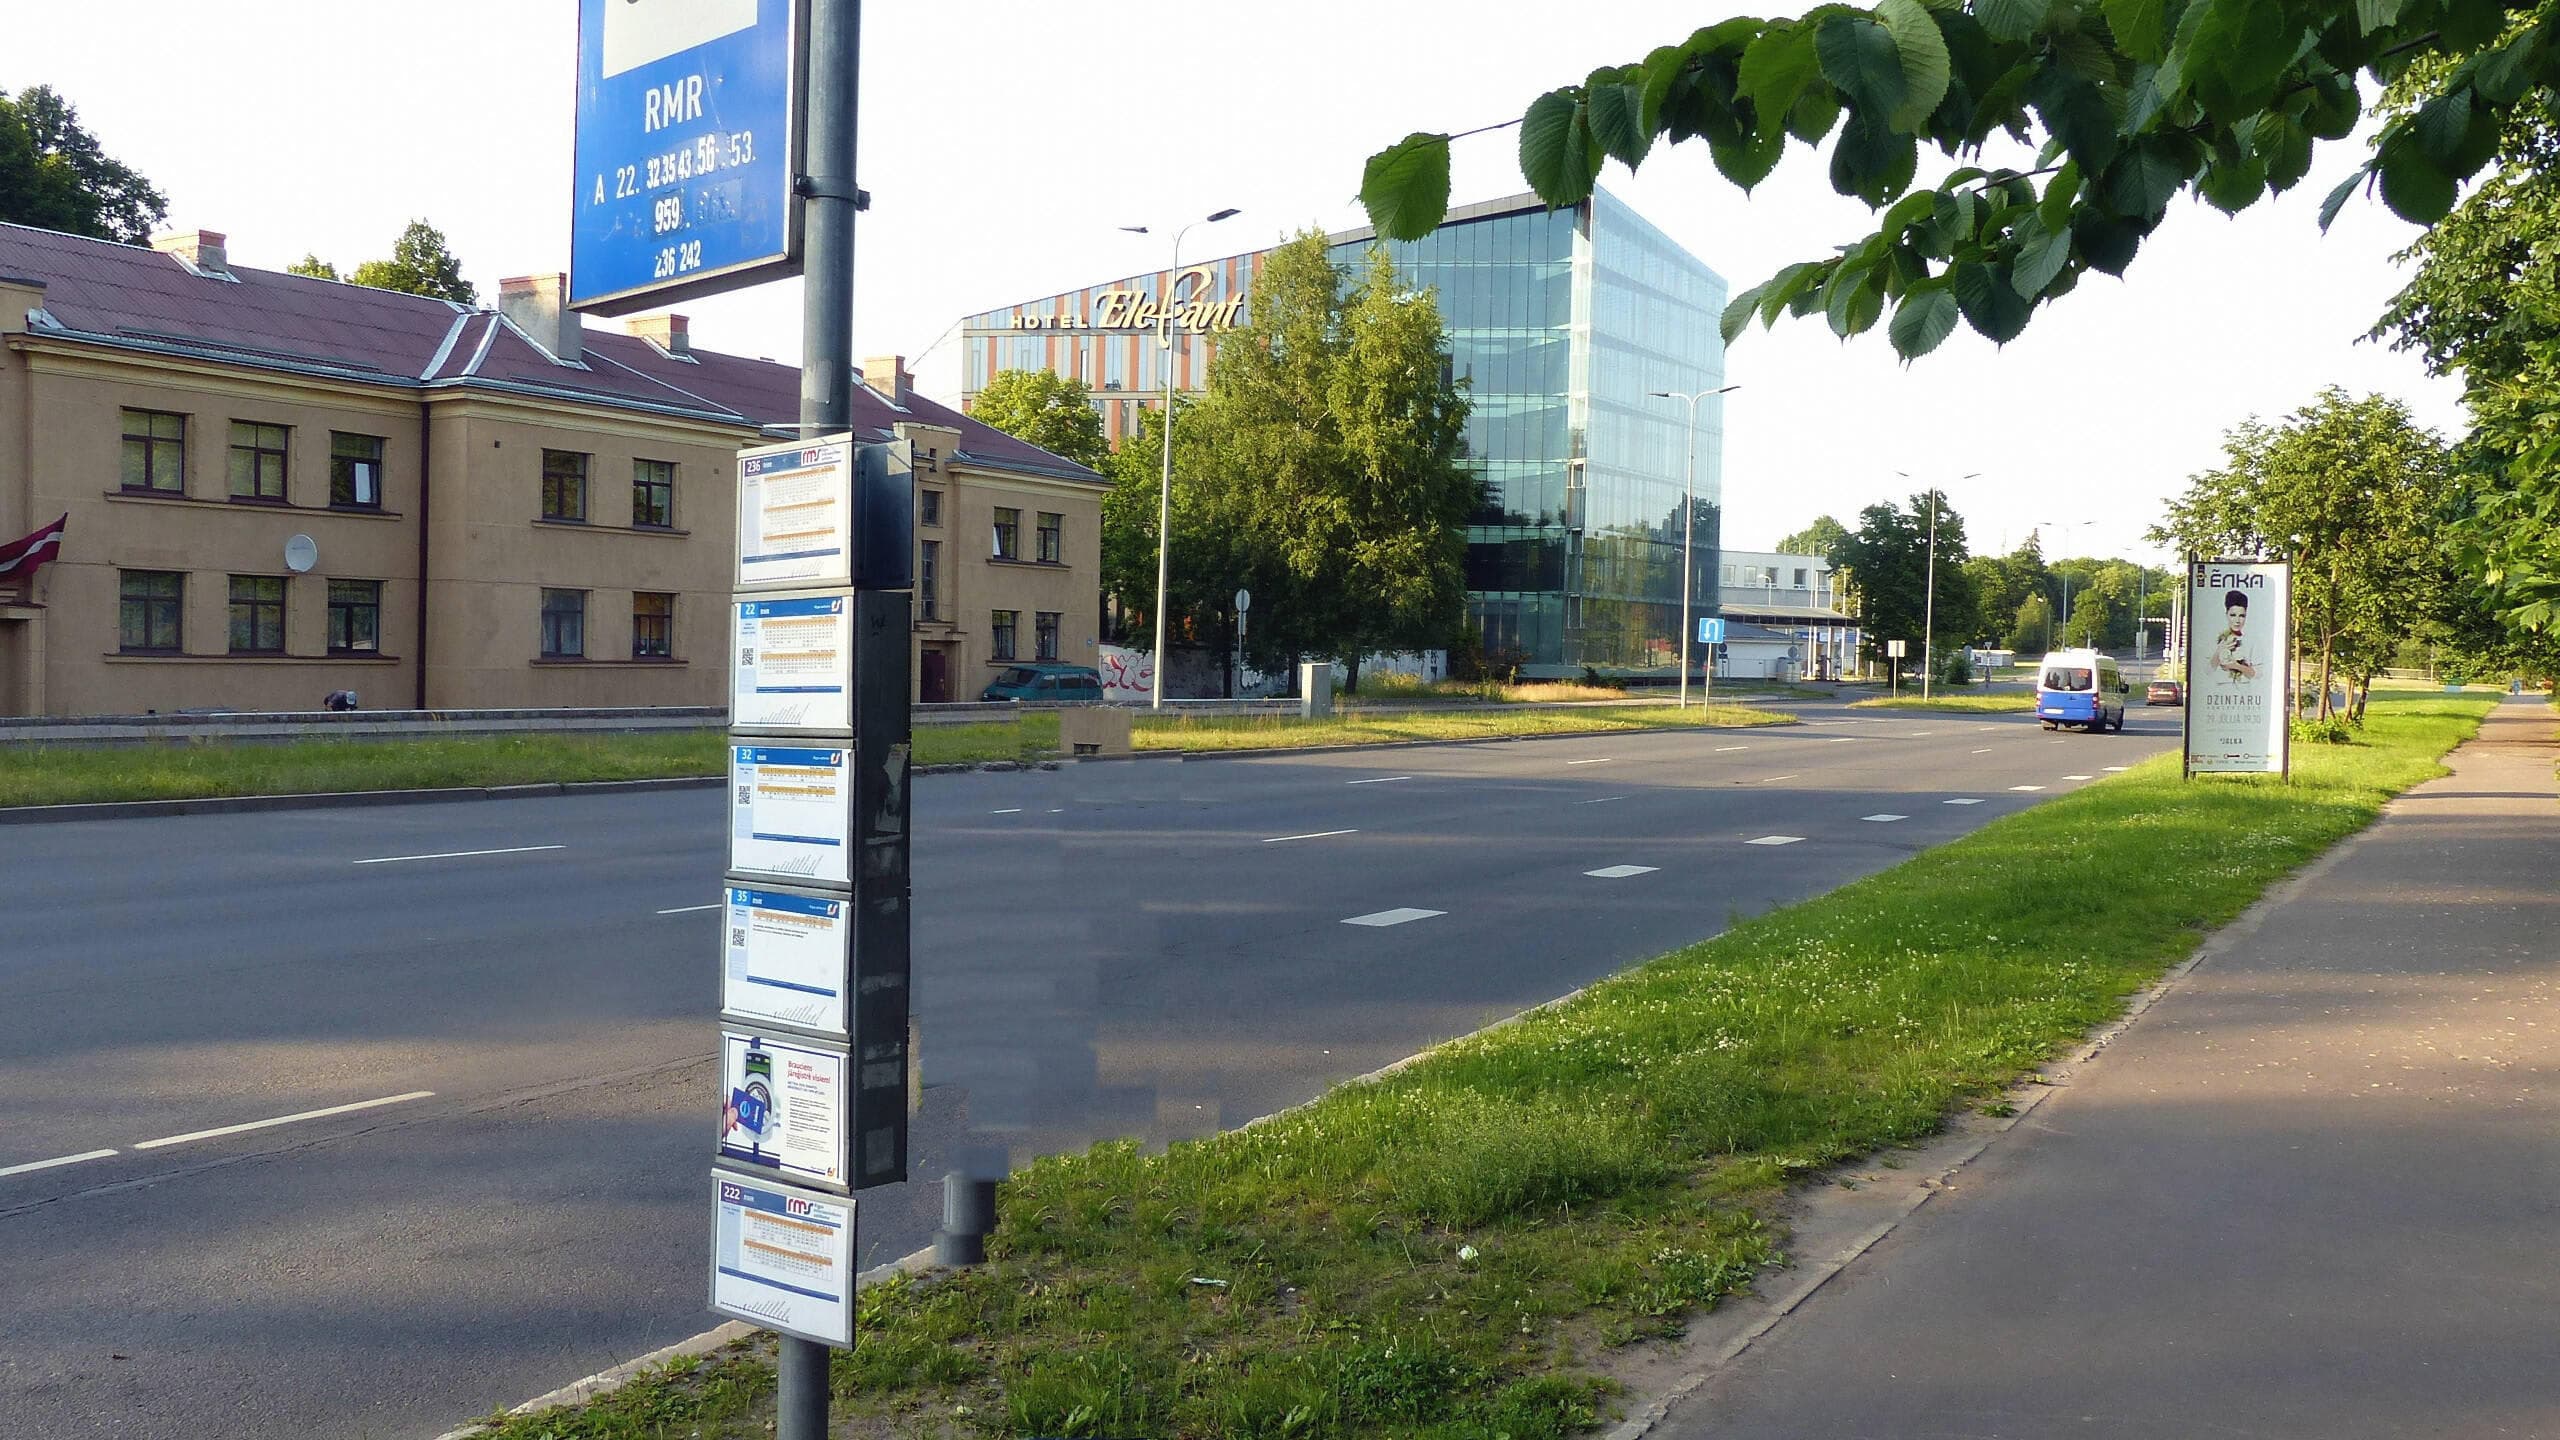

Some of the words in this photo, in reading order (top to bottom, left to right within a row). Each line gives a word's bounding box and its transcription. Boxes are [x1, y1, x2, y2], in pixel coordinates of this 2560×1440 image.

[645, 75, 702, 133] RMR
[594, 174, 605, 205] A
[679, 240, 701, 272] 242
[1009, 314, 1089, 330] HOTEL
[1095, 266, 1245, 350] Elefant
[746, 460, 761, 474] 236
[745, 604, 756, 616] 22
[2206, 694, 2262, 706] DZINTARU
[741, 748, 752, 761] 32
[736, 890, 748, 902] 35
[724, 1186, 741, 1201] 222
